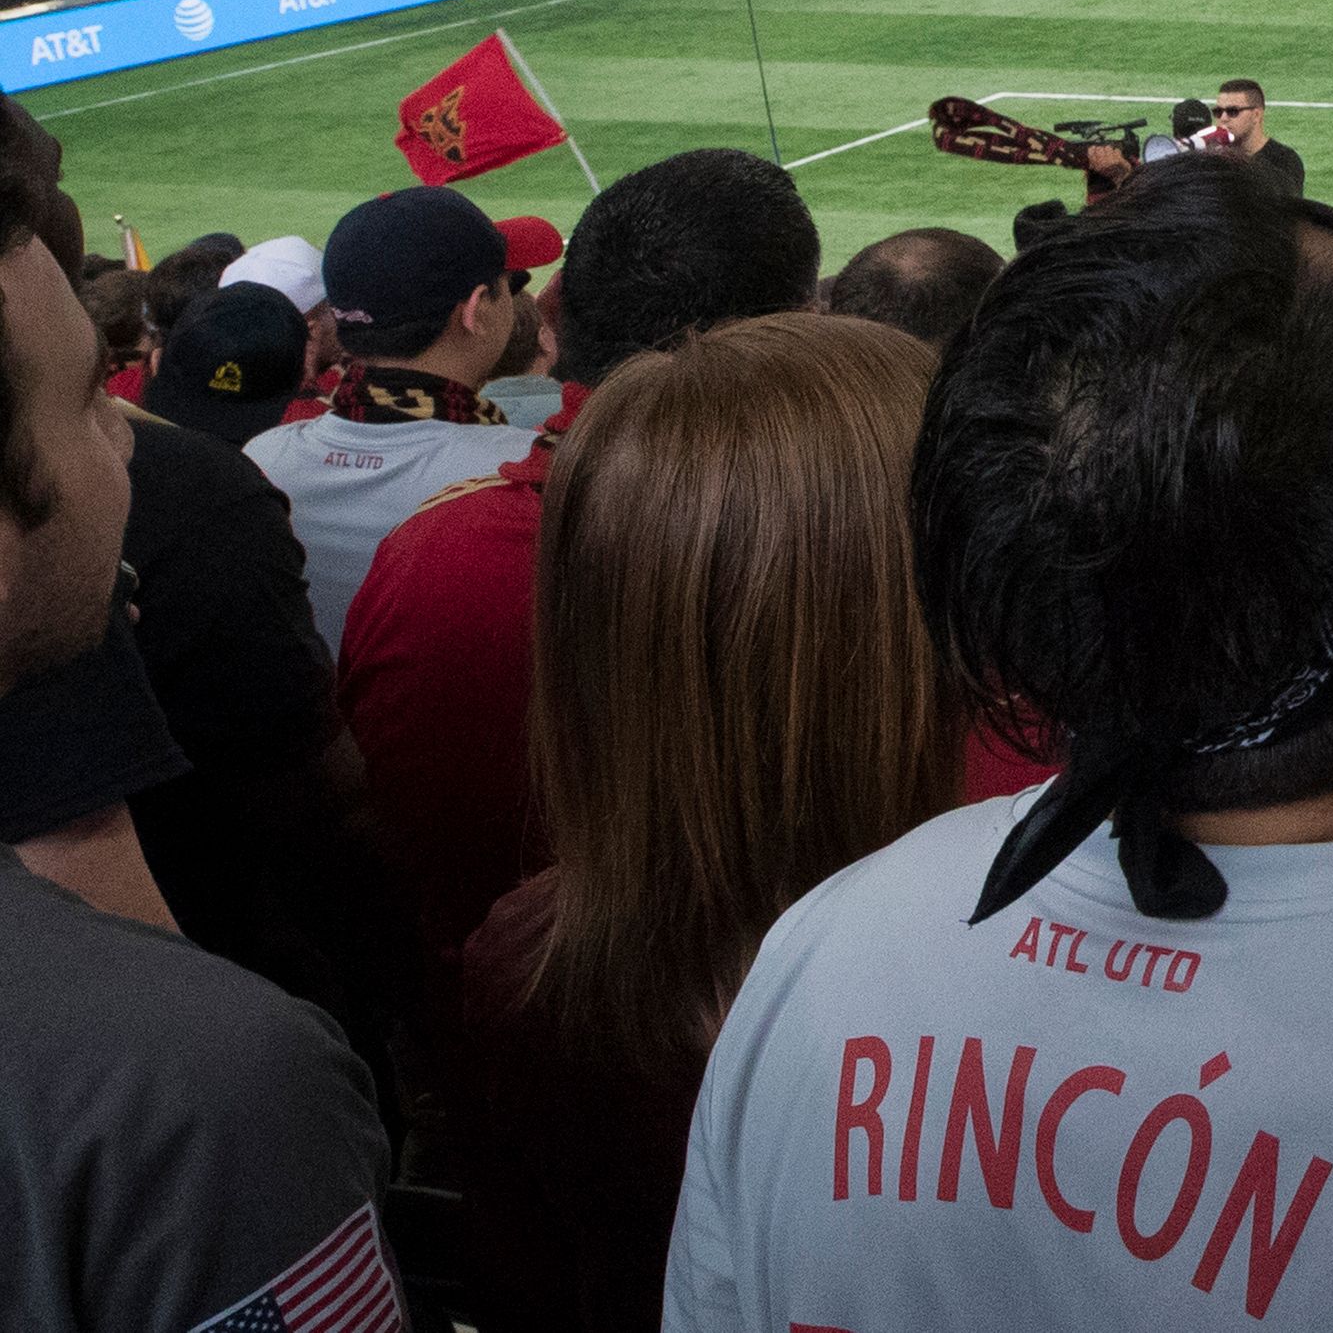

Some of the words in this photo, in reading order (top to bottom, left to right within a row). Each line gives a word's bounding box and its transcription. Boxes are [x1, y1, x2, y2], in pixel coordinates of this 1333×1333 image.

[31, 25, 103, 66] AT&T
[324, 452, 350, 467] ATL
[355, 455, 384, 470] UTD
[1010, 916, 1089, 974] ATL
[1104, 939, 1202, 994] UTD
[833, 1035, 1333, 1321] RINCÓN
